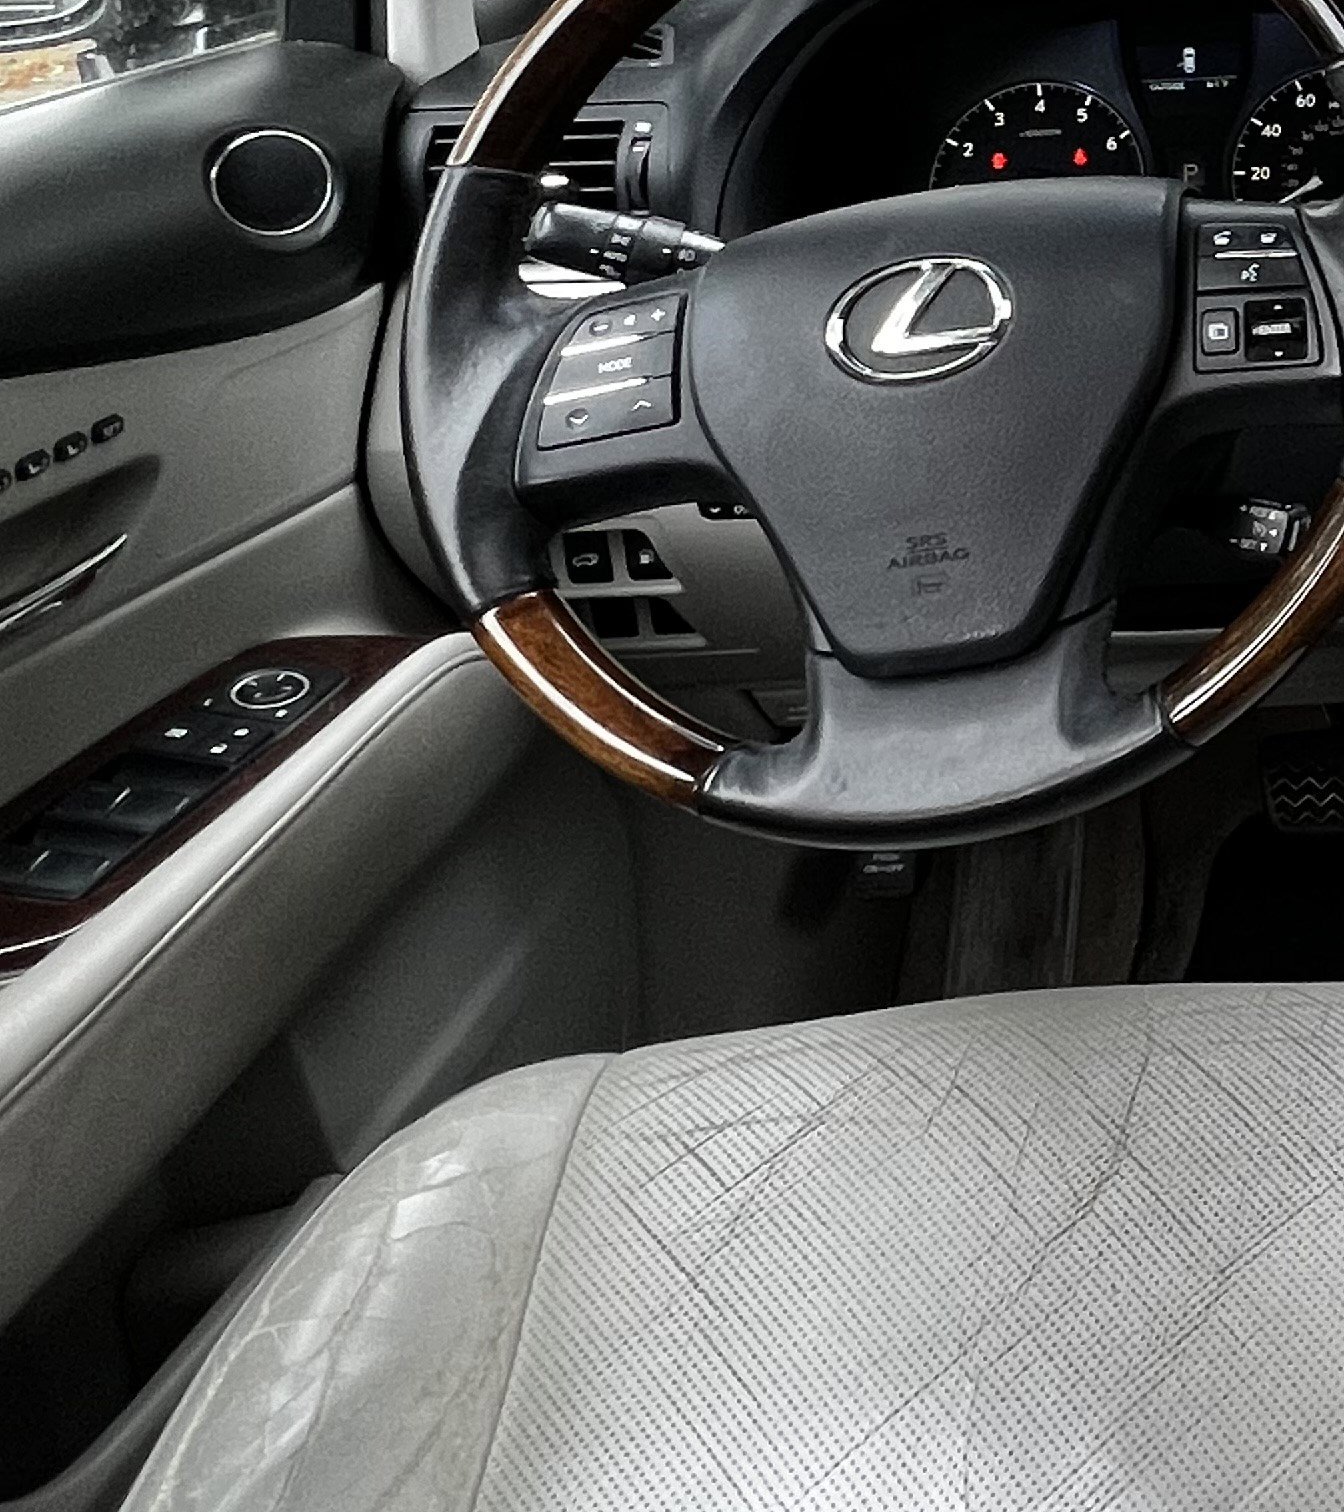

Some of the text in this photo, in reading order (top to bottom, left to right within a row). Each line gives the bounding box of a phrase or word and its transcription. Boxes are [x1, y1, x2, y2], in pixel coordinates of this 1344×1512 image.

[1033, 99, 1046, 113] 4
[1295, 93, 1317, 108] 60
[993, 112, 1005, 126] 3
[1076, 108, 1088, 122] 5
[1261, 123, 1282, 138] 40
[962, 142, 974, 157] 2
[1106, 137, 1118, 151] 6
[1250, 166, 1271, 181] 20
[598, 356, 634, 374] MODE
[887, 548, 970, 570] AIRBAG
